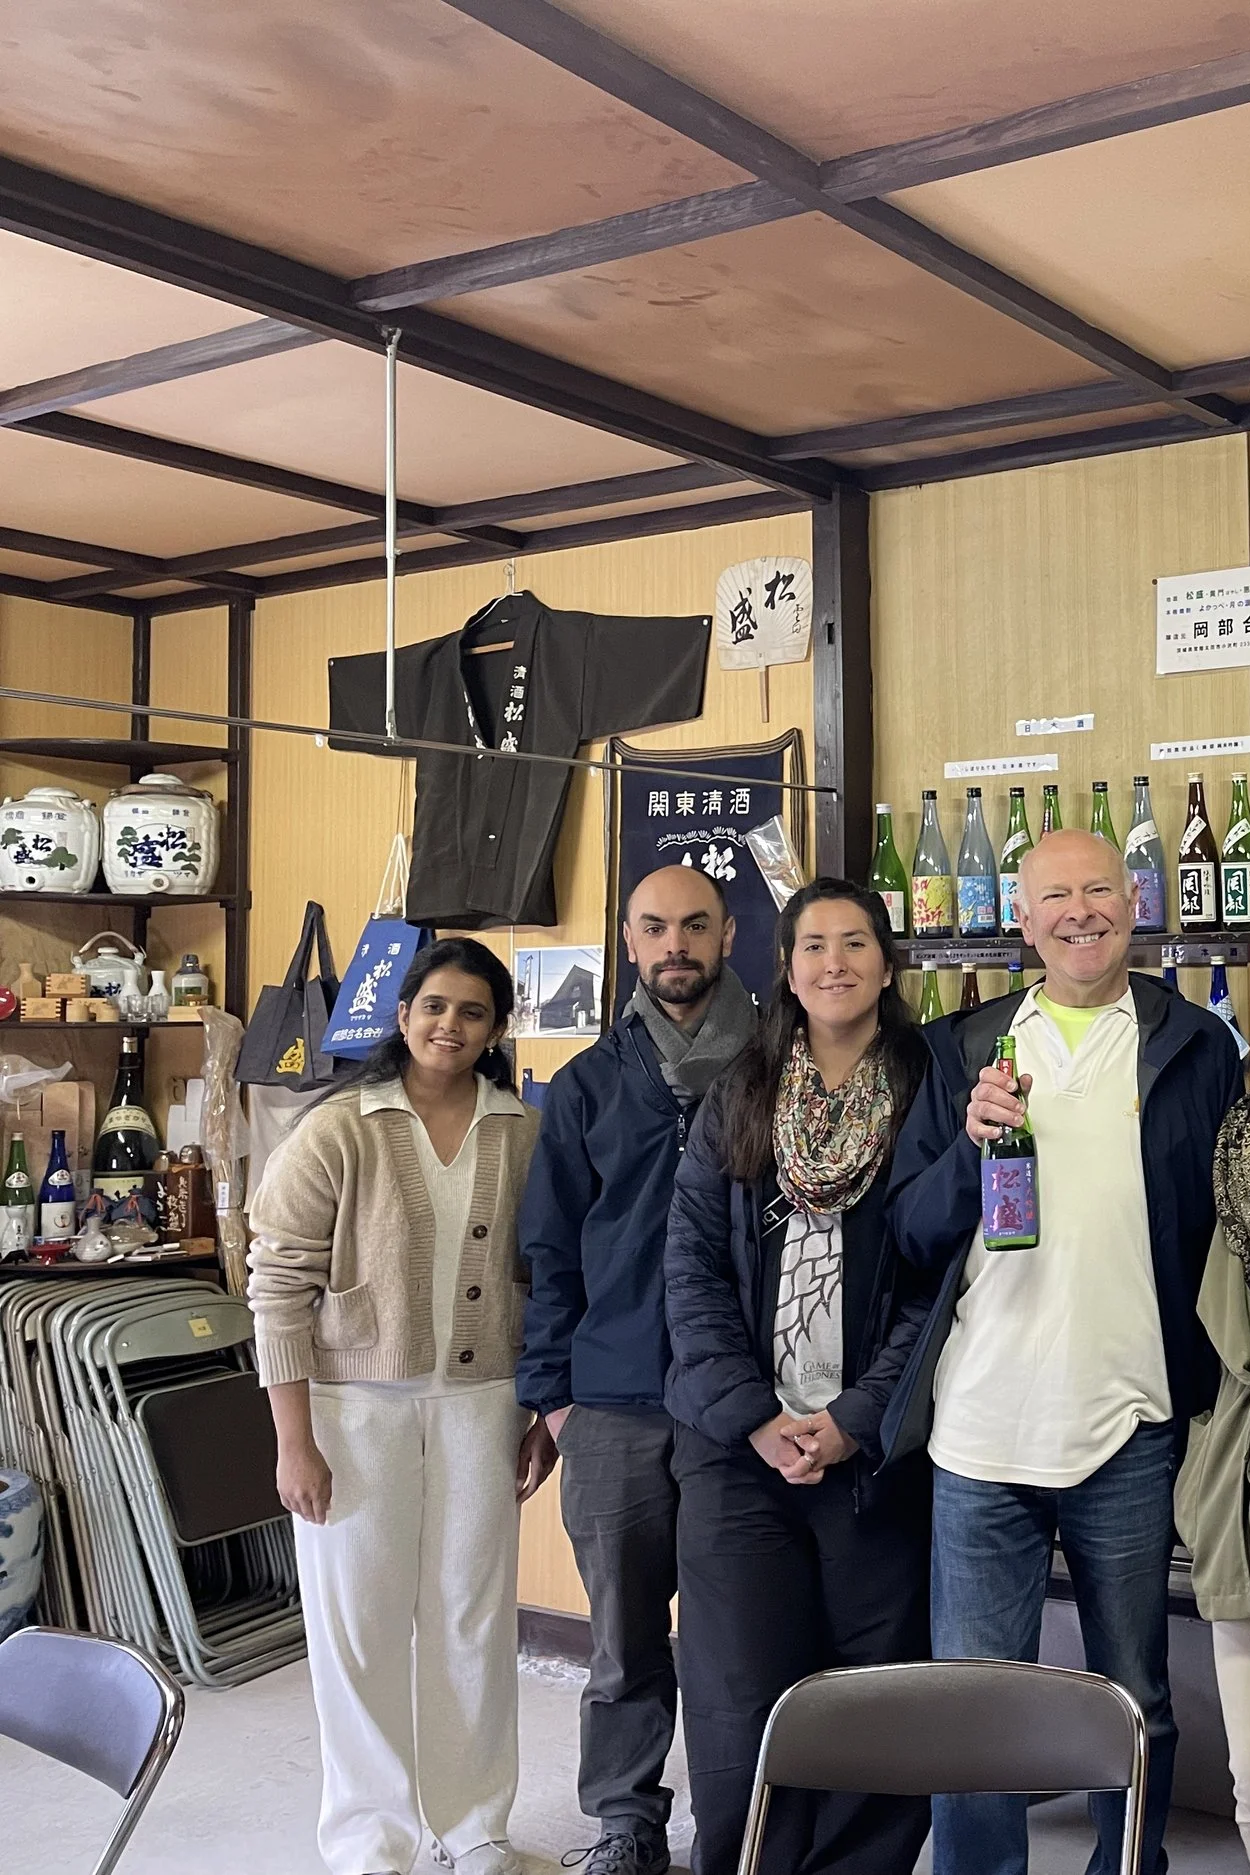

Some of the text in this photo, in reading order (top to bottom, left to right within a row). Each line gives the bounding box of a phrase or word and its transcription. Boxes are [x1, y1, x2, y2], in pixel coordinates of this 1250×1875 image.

[729, 570, 796, 645] 松盛
[510, 666, 527, 699] 清酒
[648, 788, 751, 817] 関東清酒
[14, 834, 52, 864] 松盛
[129, 825, 187, 868] 松盛
[348, 959, 392, 1014] 松盛
[990, 1164, 1024, 1231] 松盛
[798, 1370, 841, 1386] THRONES
[803, 1360, 832, 1374] GAME
